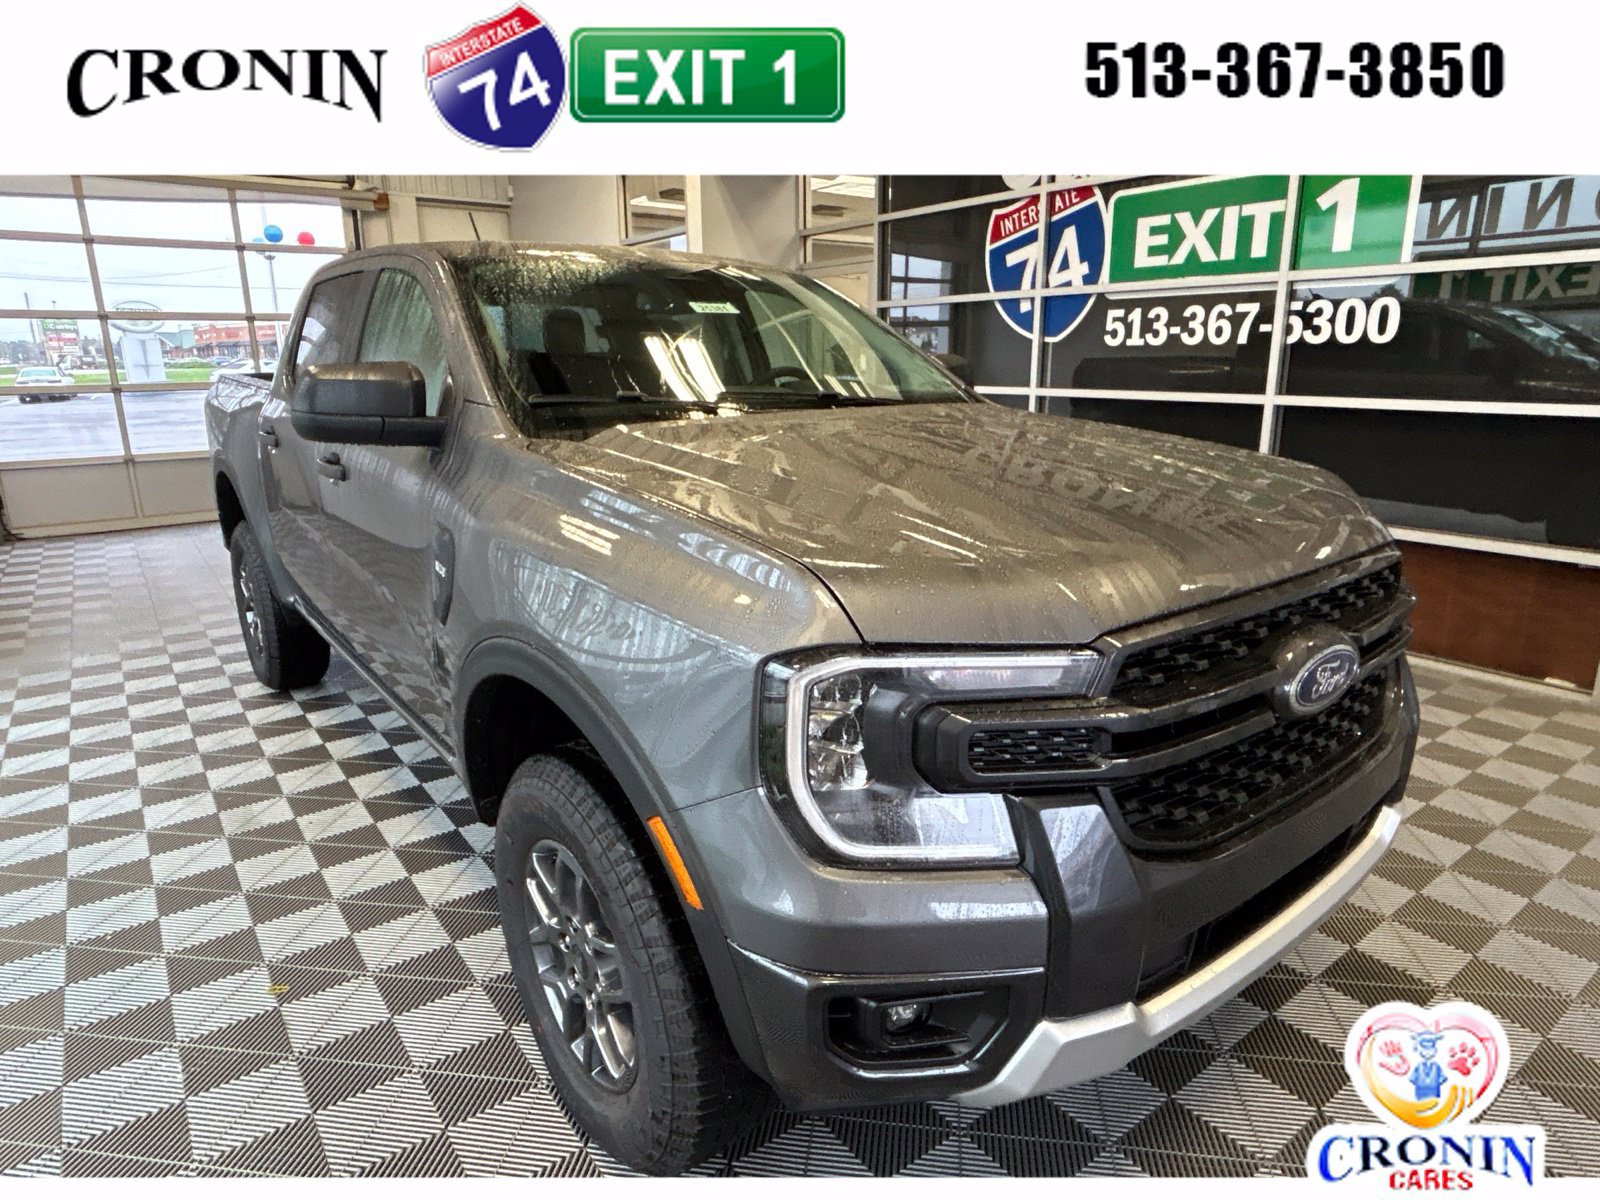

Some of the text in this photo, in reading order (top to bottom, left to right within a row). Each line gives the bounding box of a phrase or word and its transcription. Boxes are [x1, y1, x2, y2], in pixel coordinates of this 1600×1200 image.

[1000, 189, 1081, 237] INTERATE
[1134, 177, 1361, 269] EXIT 1
[1005, 225, 1090, 313] 74
[1103, 296, 1401, 347] 513-367-5300
[1311, 659, 1350, 700] Ford
